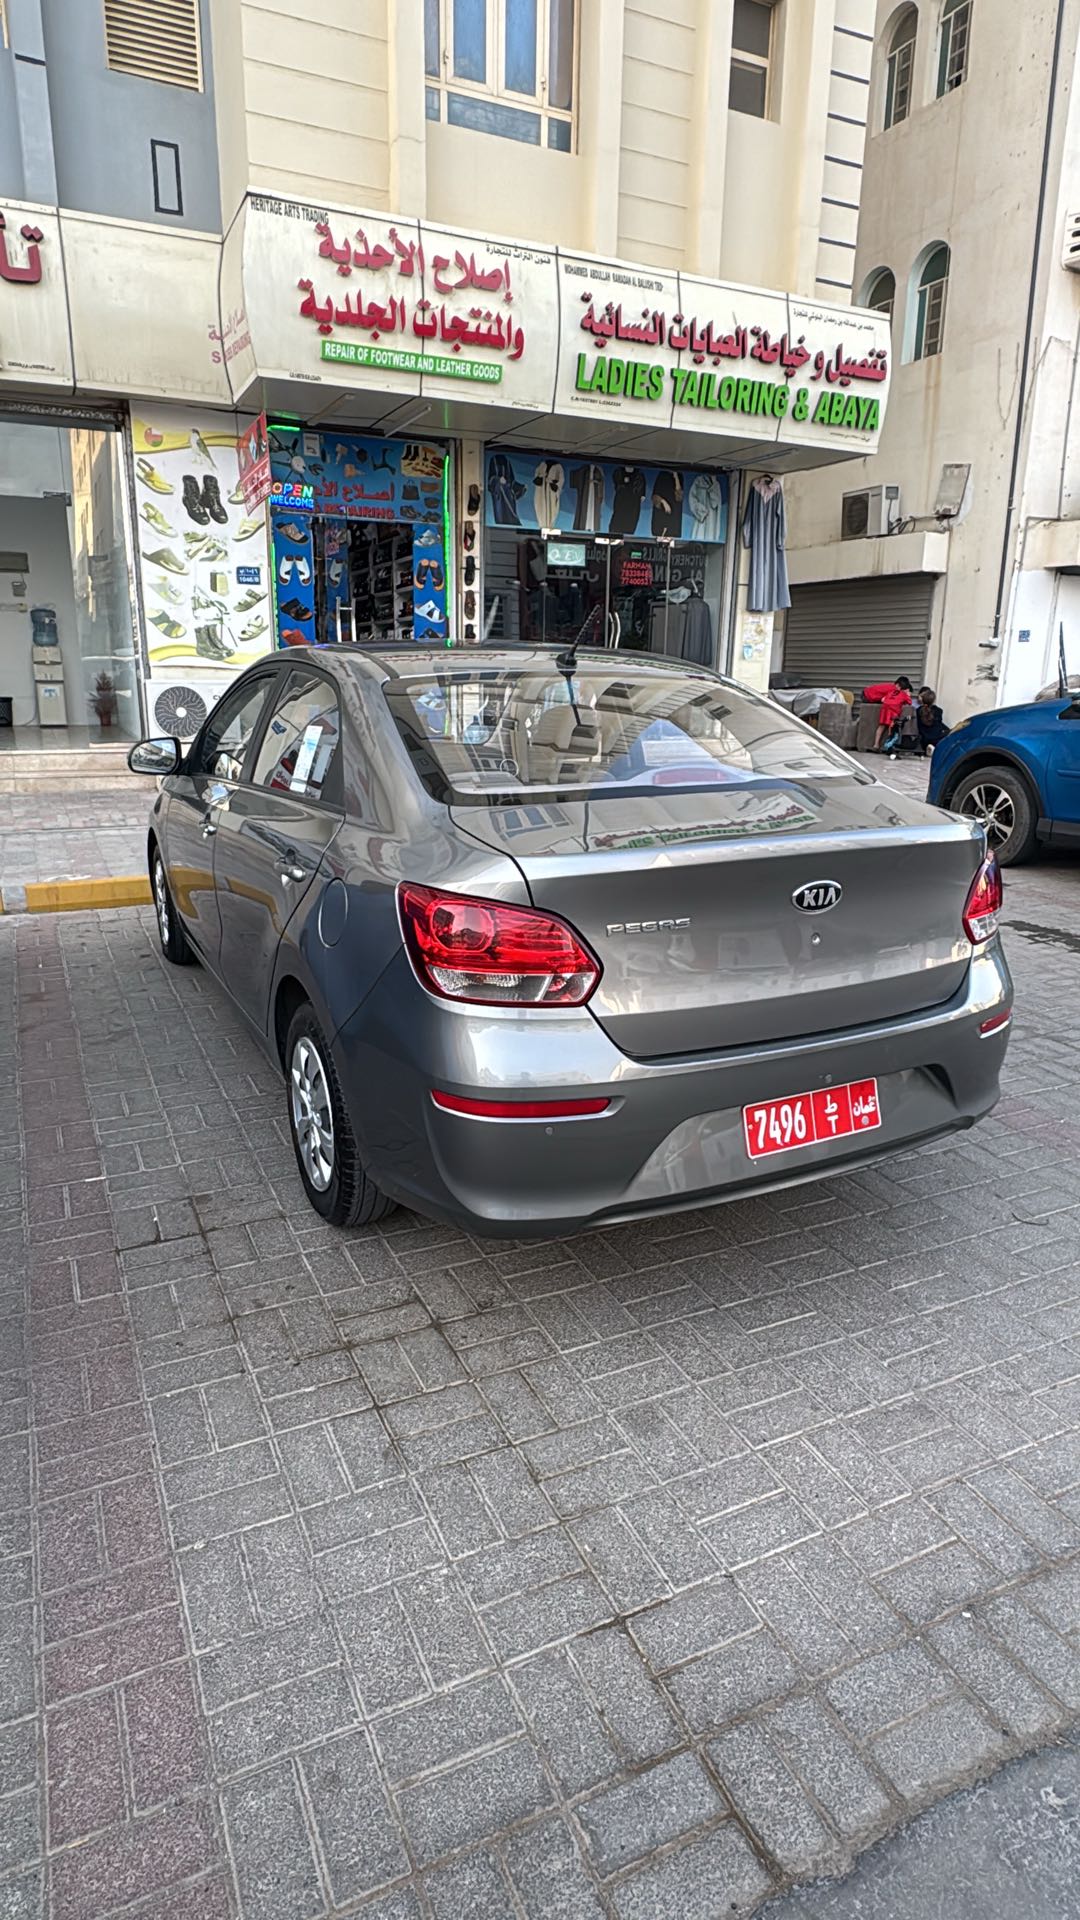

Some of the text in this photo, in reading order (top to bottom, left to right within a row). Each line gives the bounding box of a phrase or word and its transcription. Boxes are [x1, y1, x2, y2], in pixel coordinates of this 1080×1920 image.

[251, 197, 330, 225] HERITAGE ARTS TRADING
[315, 222, 513, 305] إصلاح الأحذية
[534, 256, 551, 265] فنون
[298, 278, 406, 341] الجلدية
[413, 300, 525, 361] والمنتجات
[580, 291, 888, 387] تفصيل و خياطة العبايات النسائية
[324, 342, 501, 380] REPAIR OF FOOTWEAR AND LEATHER GOODS
[575, 353, 880, 431] LADIES TAILORING & ABAYA
[270, 494, 314, 509] WELCOME
[272, 482, 314, 498] OPEN
[802, 887, 836, 907] KIA
[754, 1101, 807, 1149] 7496
[827, 1114, 839, 1134] T
